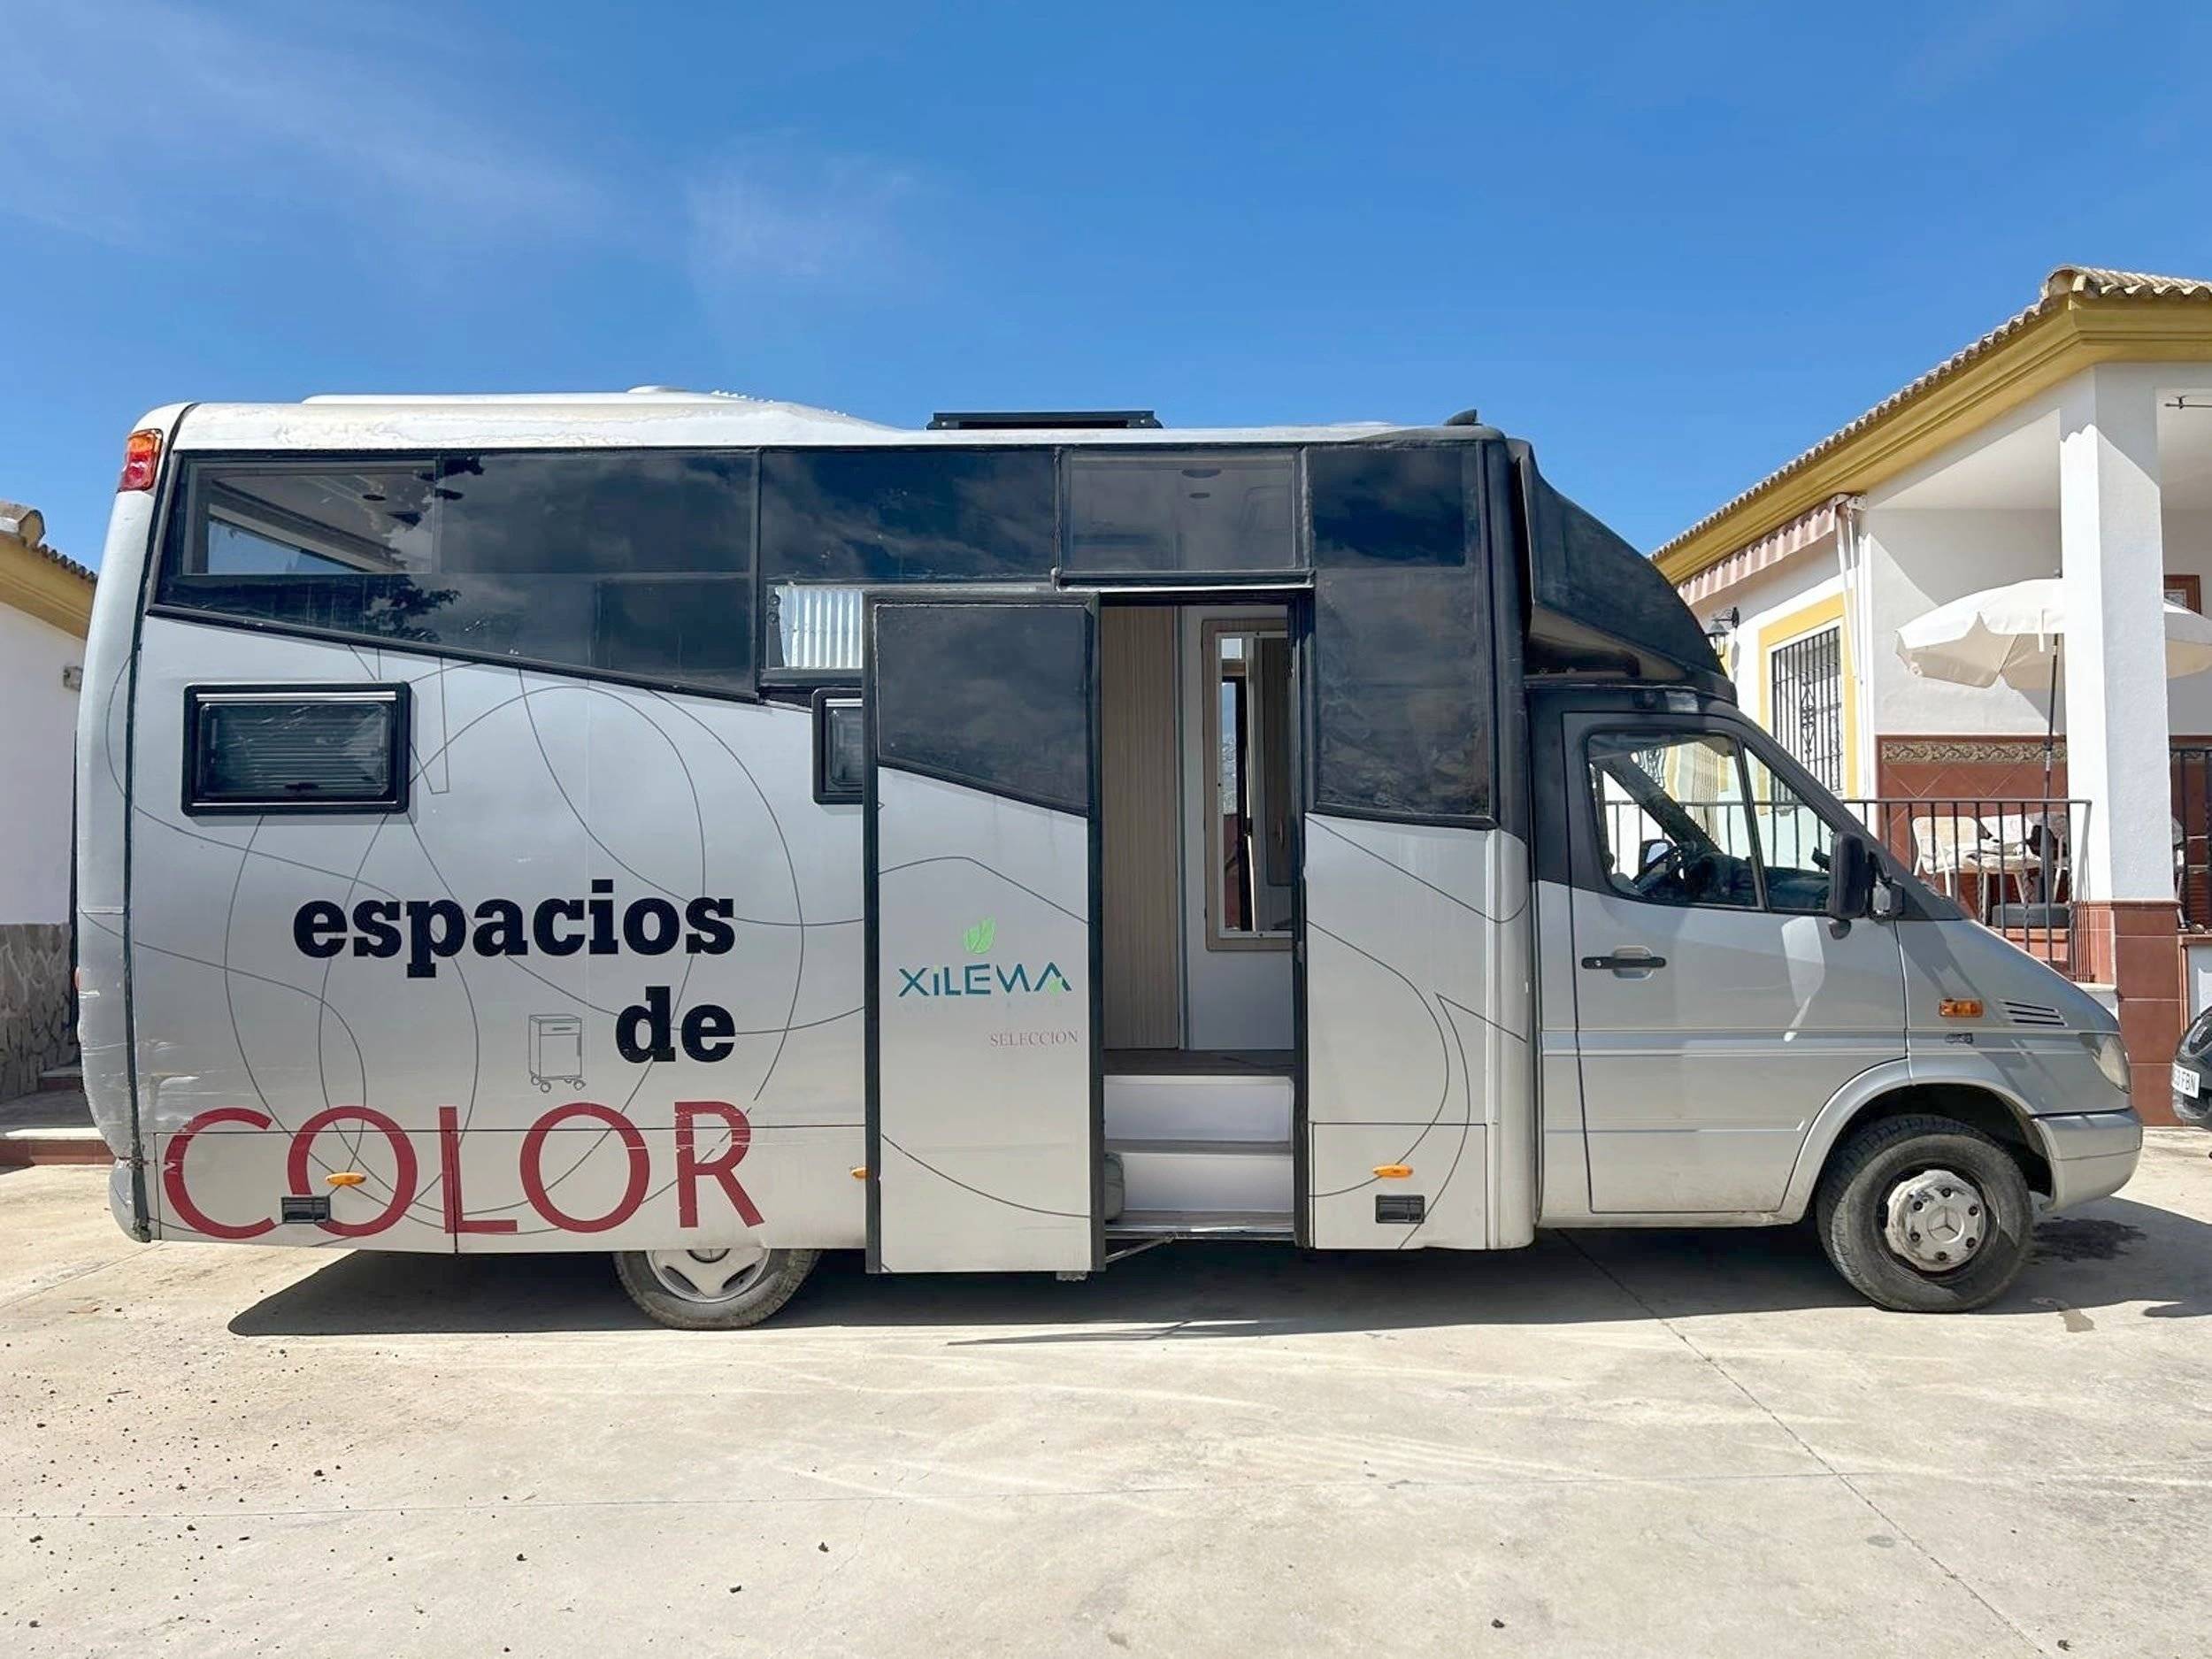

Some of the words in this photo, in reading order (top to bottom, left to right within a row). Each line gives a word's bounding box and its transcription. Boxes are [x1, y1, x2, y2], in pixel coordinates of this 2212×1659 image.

[293, 879, 735, 978] espacios
[615, 986, 735, 1064] de
[164, 1101, 764, 1239] COLOR
